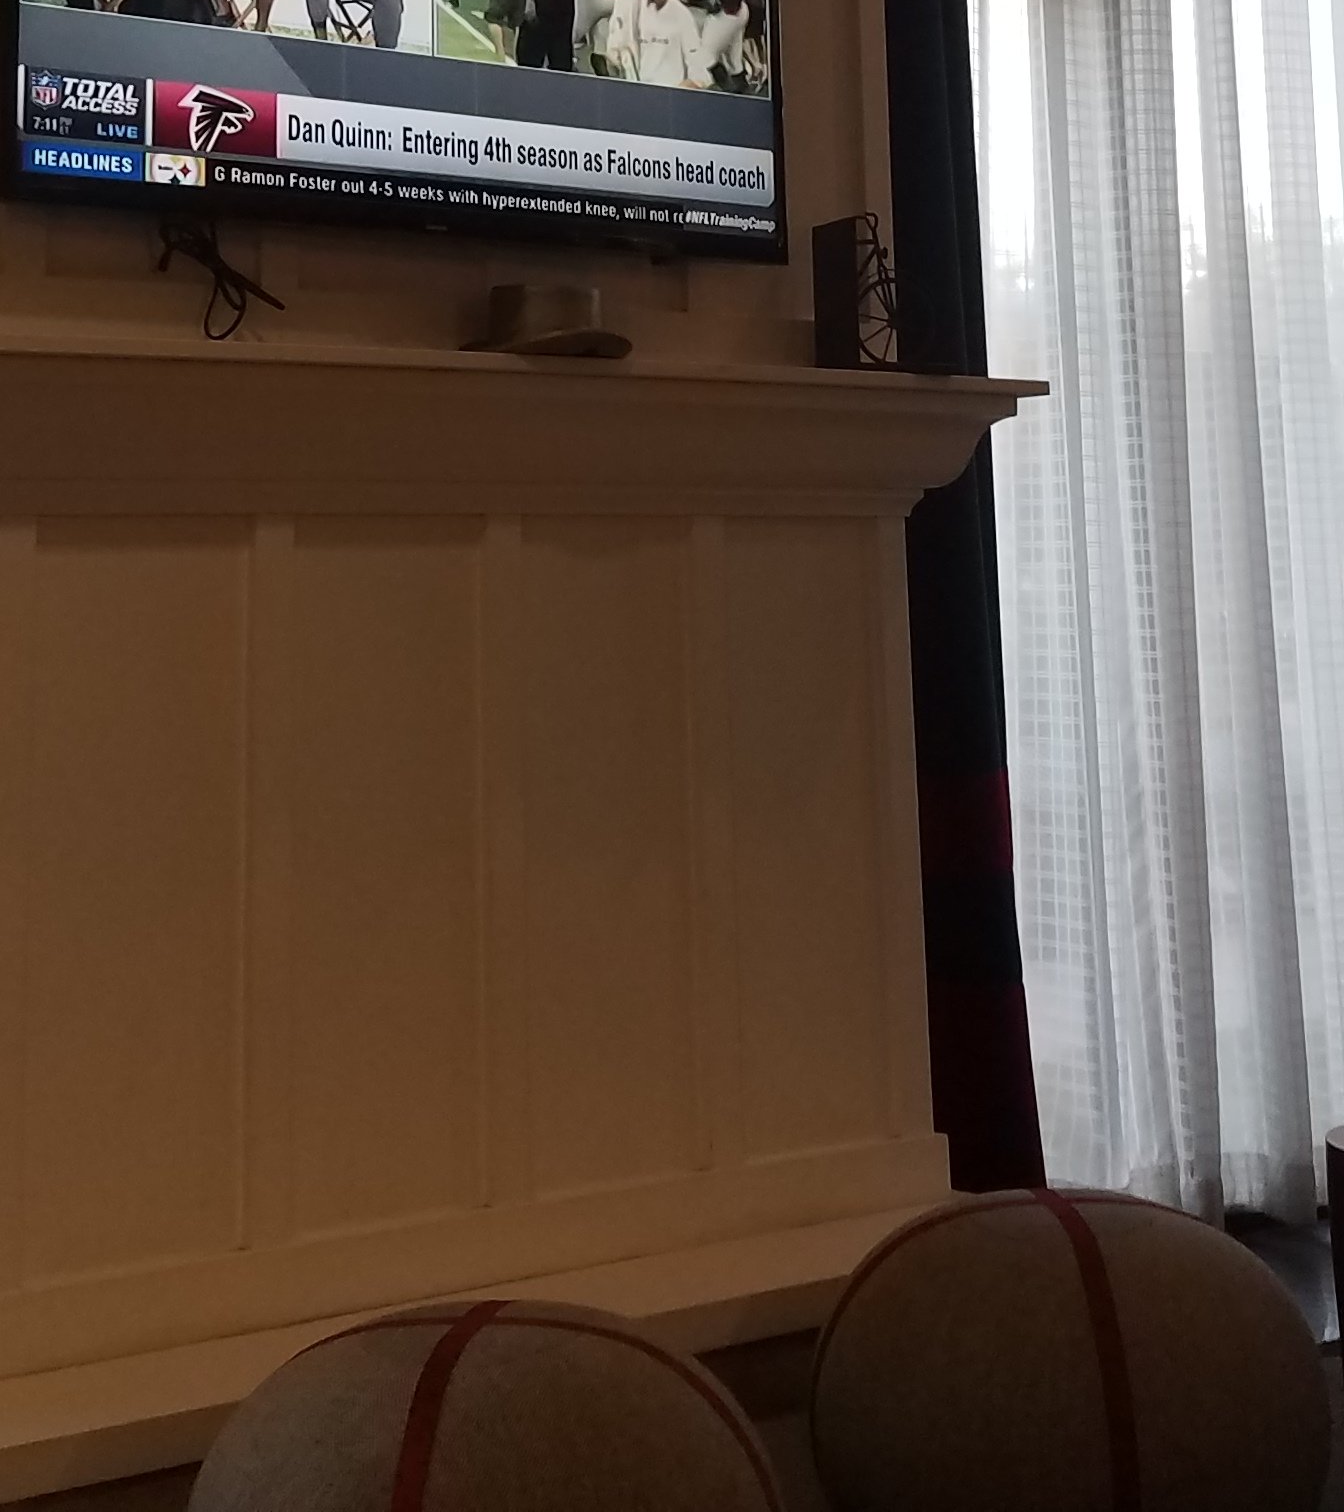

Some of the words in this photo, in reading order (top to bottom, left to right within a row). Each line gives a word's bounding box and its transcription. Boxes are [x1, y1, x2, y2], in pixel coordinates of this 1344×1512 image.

[62, 76, 140, 103] TOTAL
[61, 96, 139, 116] ACCESS
[32, 115, 58, 132] 7:11
[96, 122, 138, 139] LIVE
[33, 148, 133, 173] HEADLINES
[287, 114, 325, 144] Dan
[331, 118, 393, 151] Quinn:
[401, 126, 479, 166] Entering
[483, 135, 512, 164] 4th
[516, 145, 579, 171] season
[583, 153, 603, 173] as
[607, 149, 671, 180] Falcons
[675, 157, 714, 186] head
[718, 165, 767, 191] coach
[214, 166, 226, 182] G
[231, 168, 285, 188] Ramon
[289, 173, 336, 193] Foster
[341, 178, 365, 195] out
[368, 180, 394, 198] 4-5
[398, 185, 445, 202] weeks
[448, 189, 479, 206] with
[482, 192, 582, 215] hyperextended
[585, 200, 620, 220] knee,
[623, 204, 647, 222] will
[650, 207, 670, 223] not
